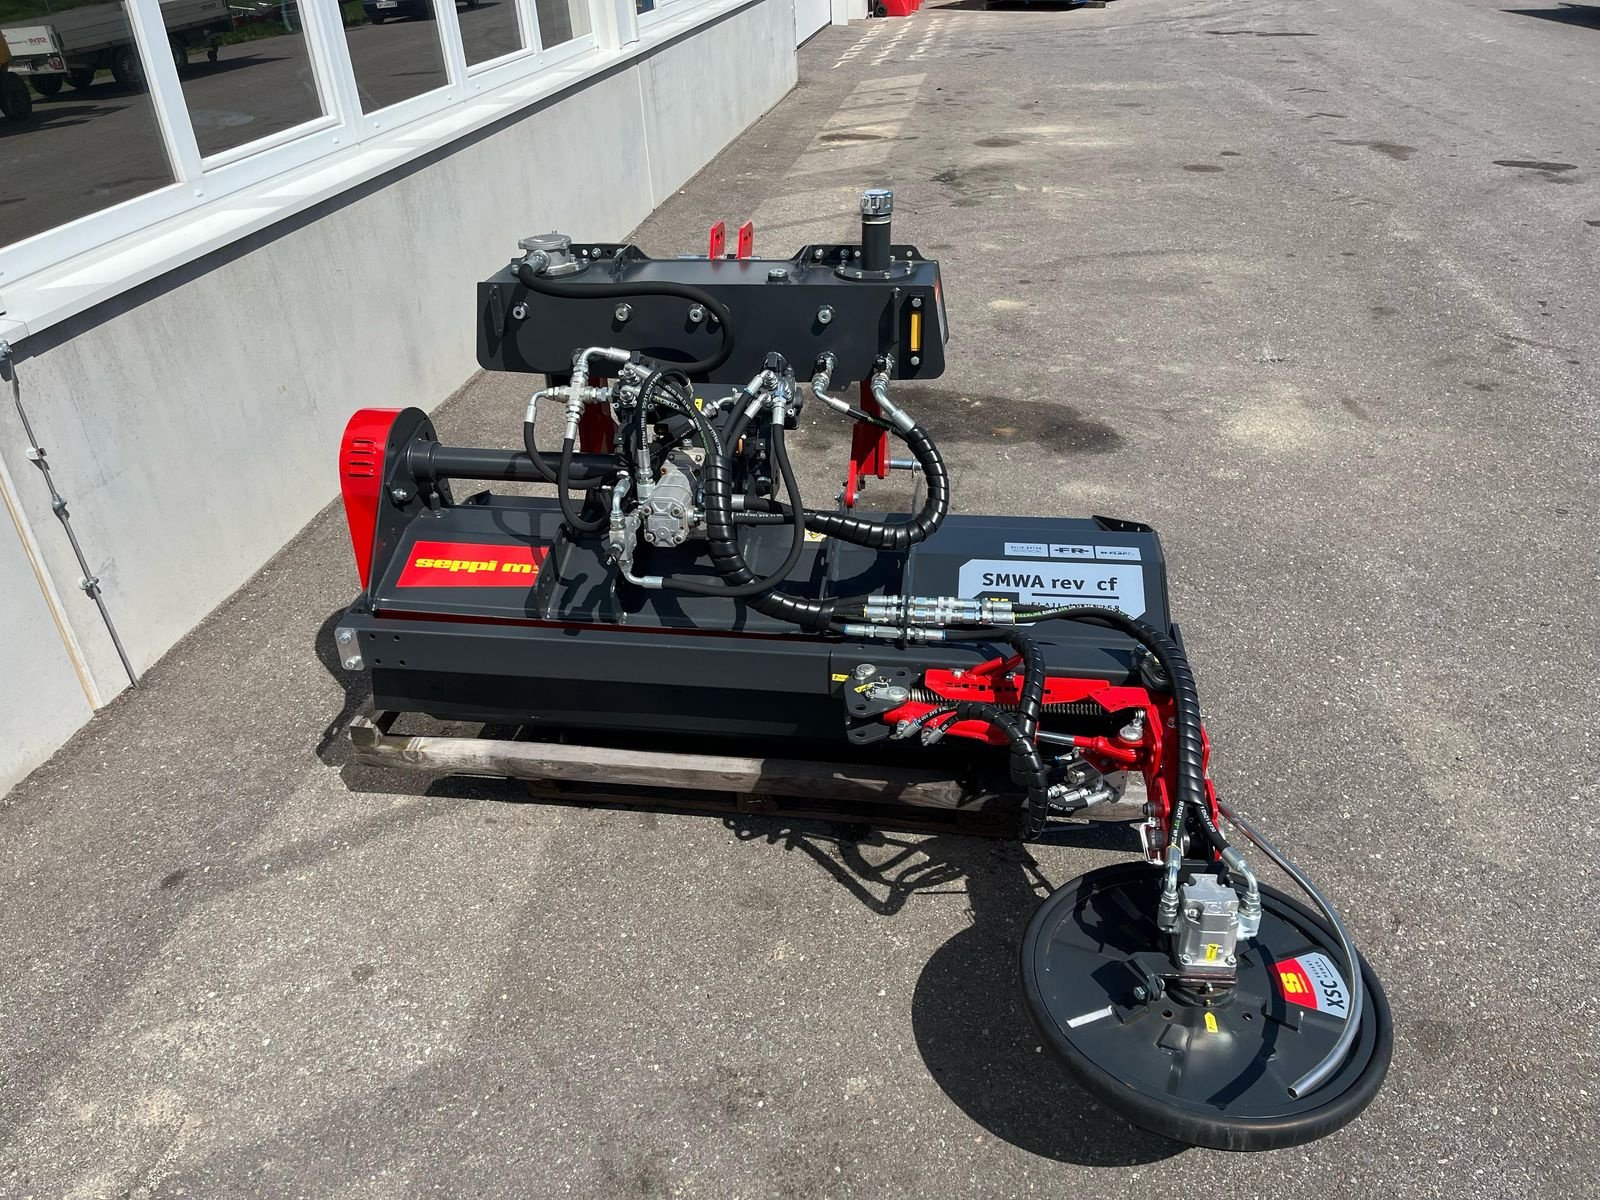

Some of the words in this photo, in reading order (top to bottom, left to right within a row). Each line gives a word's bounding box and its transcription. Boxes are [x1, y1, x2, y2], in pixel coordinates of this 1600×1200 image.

[415, 558, 498, 573] seppi
[982, 572, 1045, 589] SMWA
[1051, 577, 1085, 590] rev
[1096, 577, 1118, 591] cf
[1280, 972, 1303, 993] S
[1319, 980, 1345, 1010] XSC
